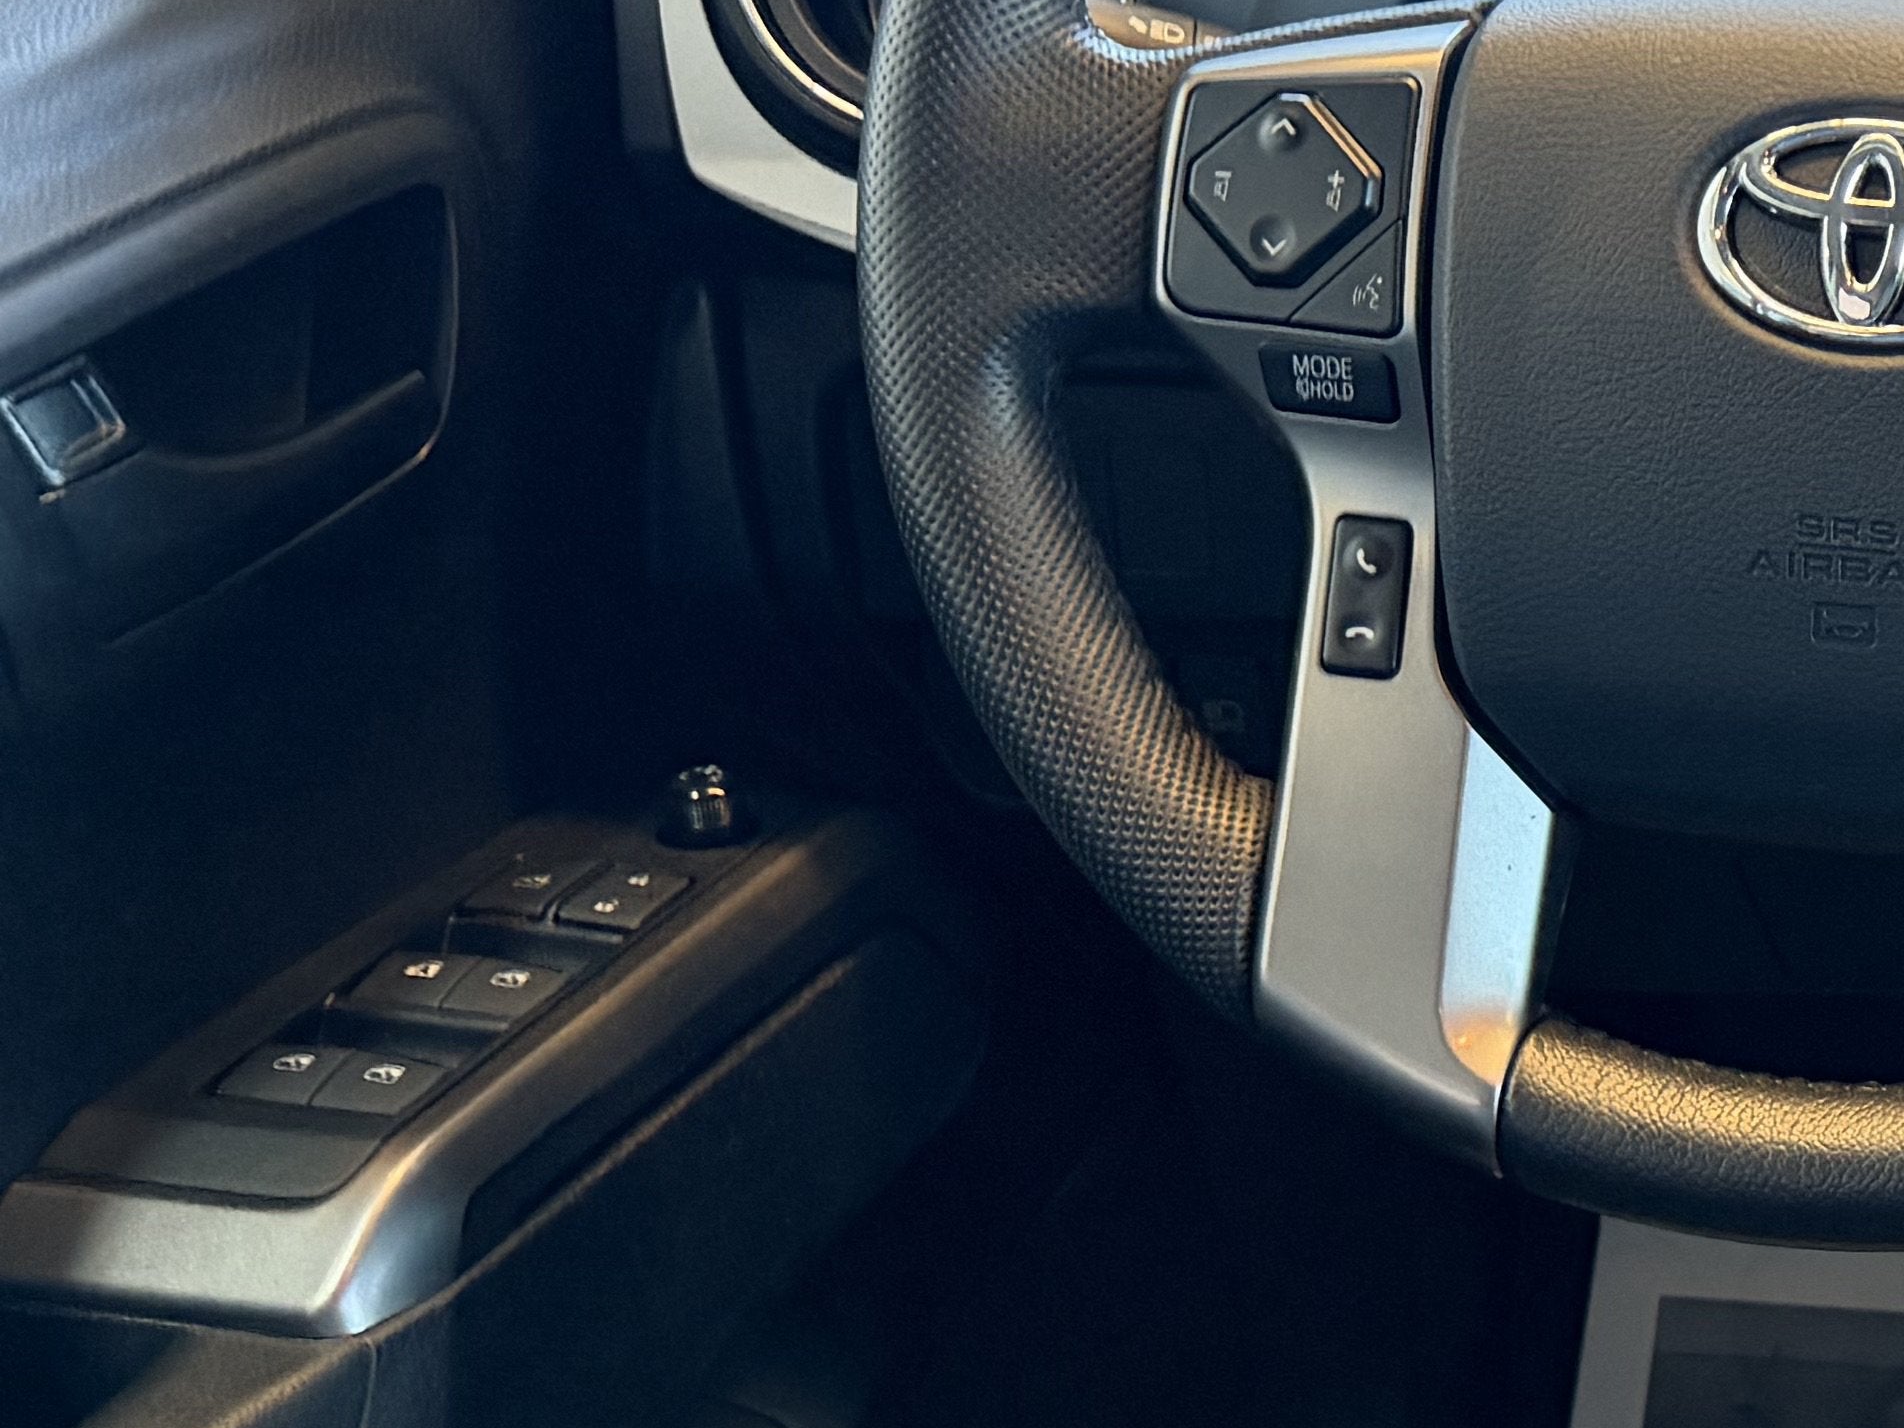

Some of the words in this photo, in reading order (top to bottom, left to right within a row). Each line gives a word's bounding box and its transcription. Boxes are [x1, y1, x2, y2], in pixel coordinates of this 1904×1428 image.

[1292, 354, 1354, 380] MODE
[1309, 379, 1355, 403] HOLD
[1796, 512, 1900, 548] SRS
